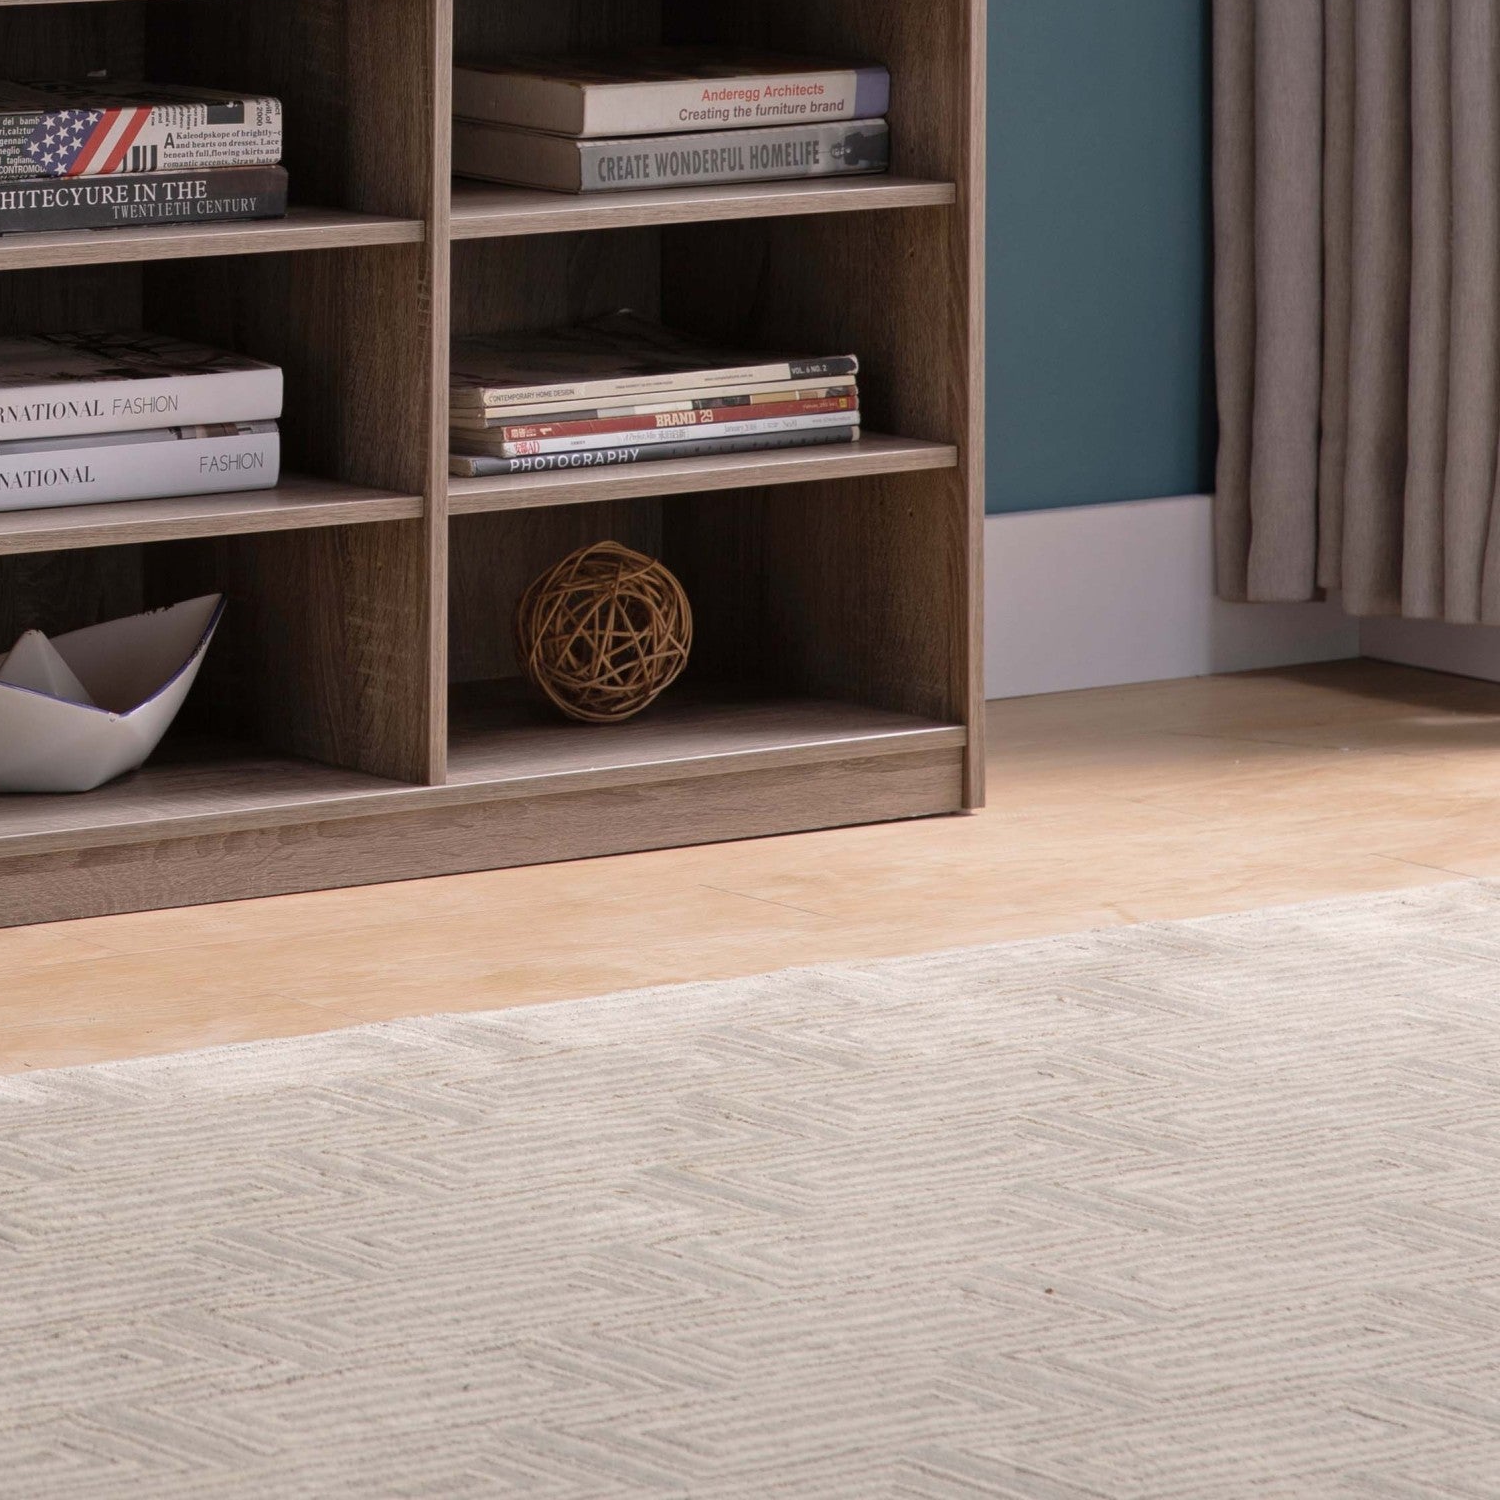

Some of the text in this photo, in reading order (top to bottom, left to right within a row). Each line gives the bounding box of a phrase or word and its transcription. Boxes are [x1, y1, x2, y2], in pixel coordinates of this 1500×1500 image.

[701, 83, 825, 103] Anderegg Architects
[679, 98, 845, 123] Creating the furniture brand
[164, 132, 175, 149] A
[231, 130, 241, 138] of
[163, 150, 194, 159] beneath
[265, 146, 280, 155] and
[175, 140, 190, 149] and
[598, 140, 821, 182] CREATE WONDERFUL HOMELIFE
[134, 183, 157, 201] IN
[161, 180, 208, 200] THE
[112, 197, 257, 221] TWENTIETH CENTURY
[822, 364, 828, 372] 2
[112, 394, 179, 416] FASHION
[489, 388, 575, 402] CONTEMPORARY HOME DESIGN
[655, 409, 714, 427] BRAND 29
[199, 451, 264, 474] FASHION
[509, 449, 640, 472] PHOTOGRAPHY
